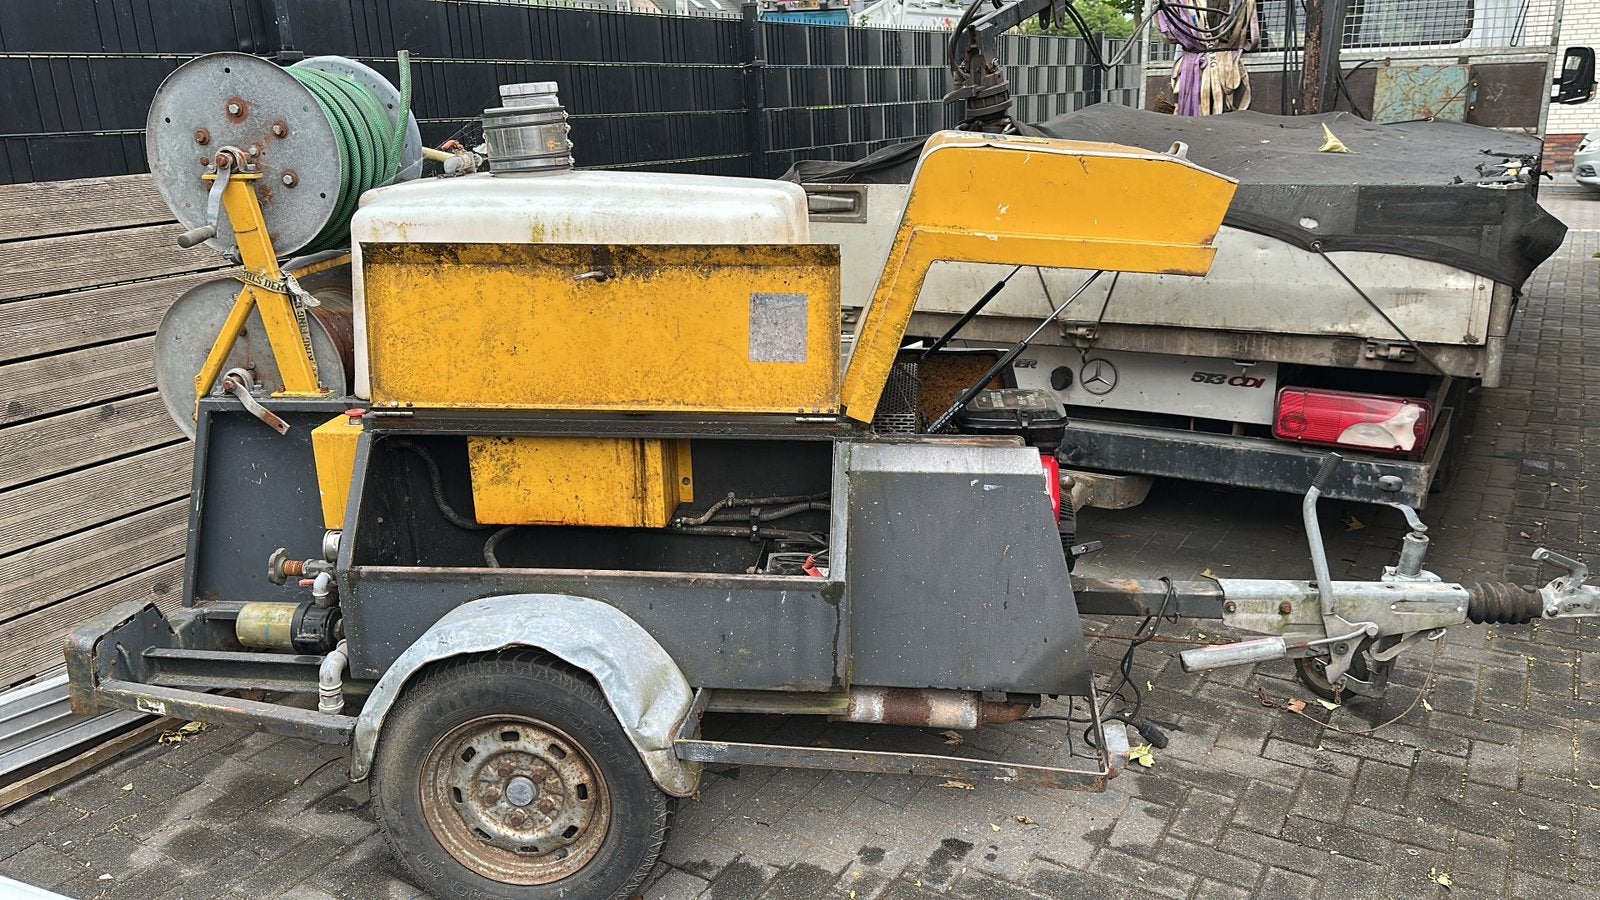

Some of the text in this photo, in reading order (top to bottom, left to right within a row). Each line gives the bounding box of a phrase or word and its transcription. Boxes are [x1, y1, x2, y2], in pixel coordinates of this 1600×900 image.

[1191, 371, 1266, 389] 513 CDI
[508, 690, 622, 768] TYFOON
